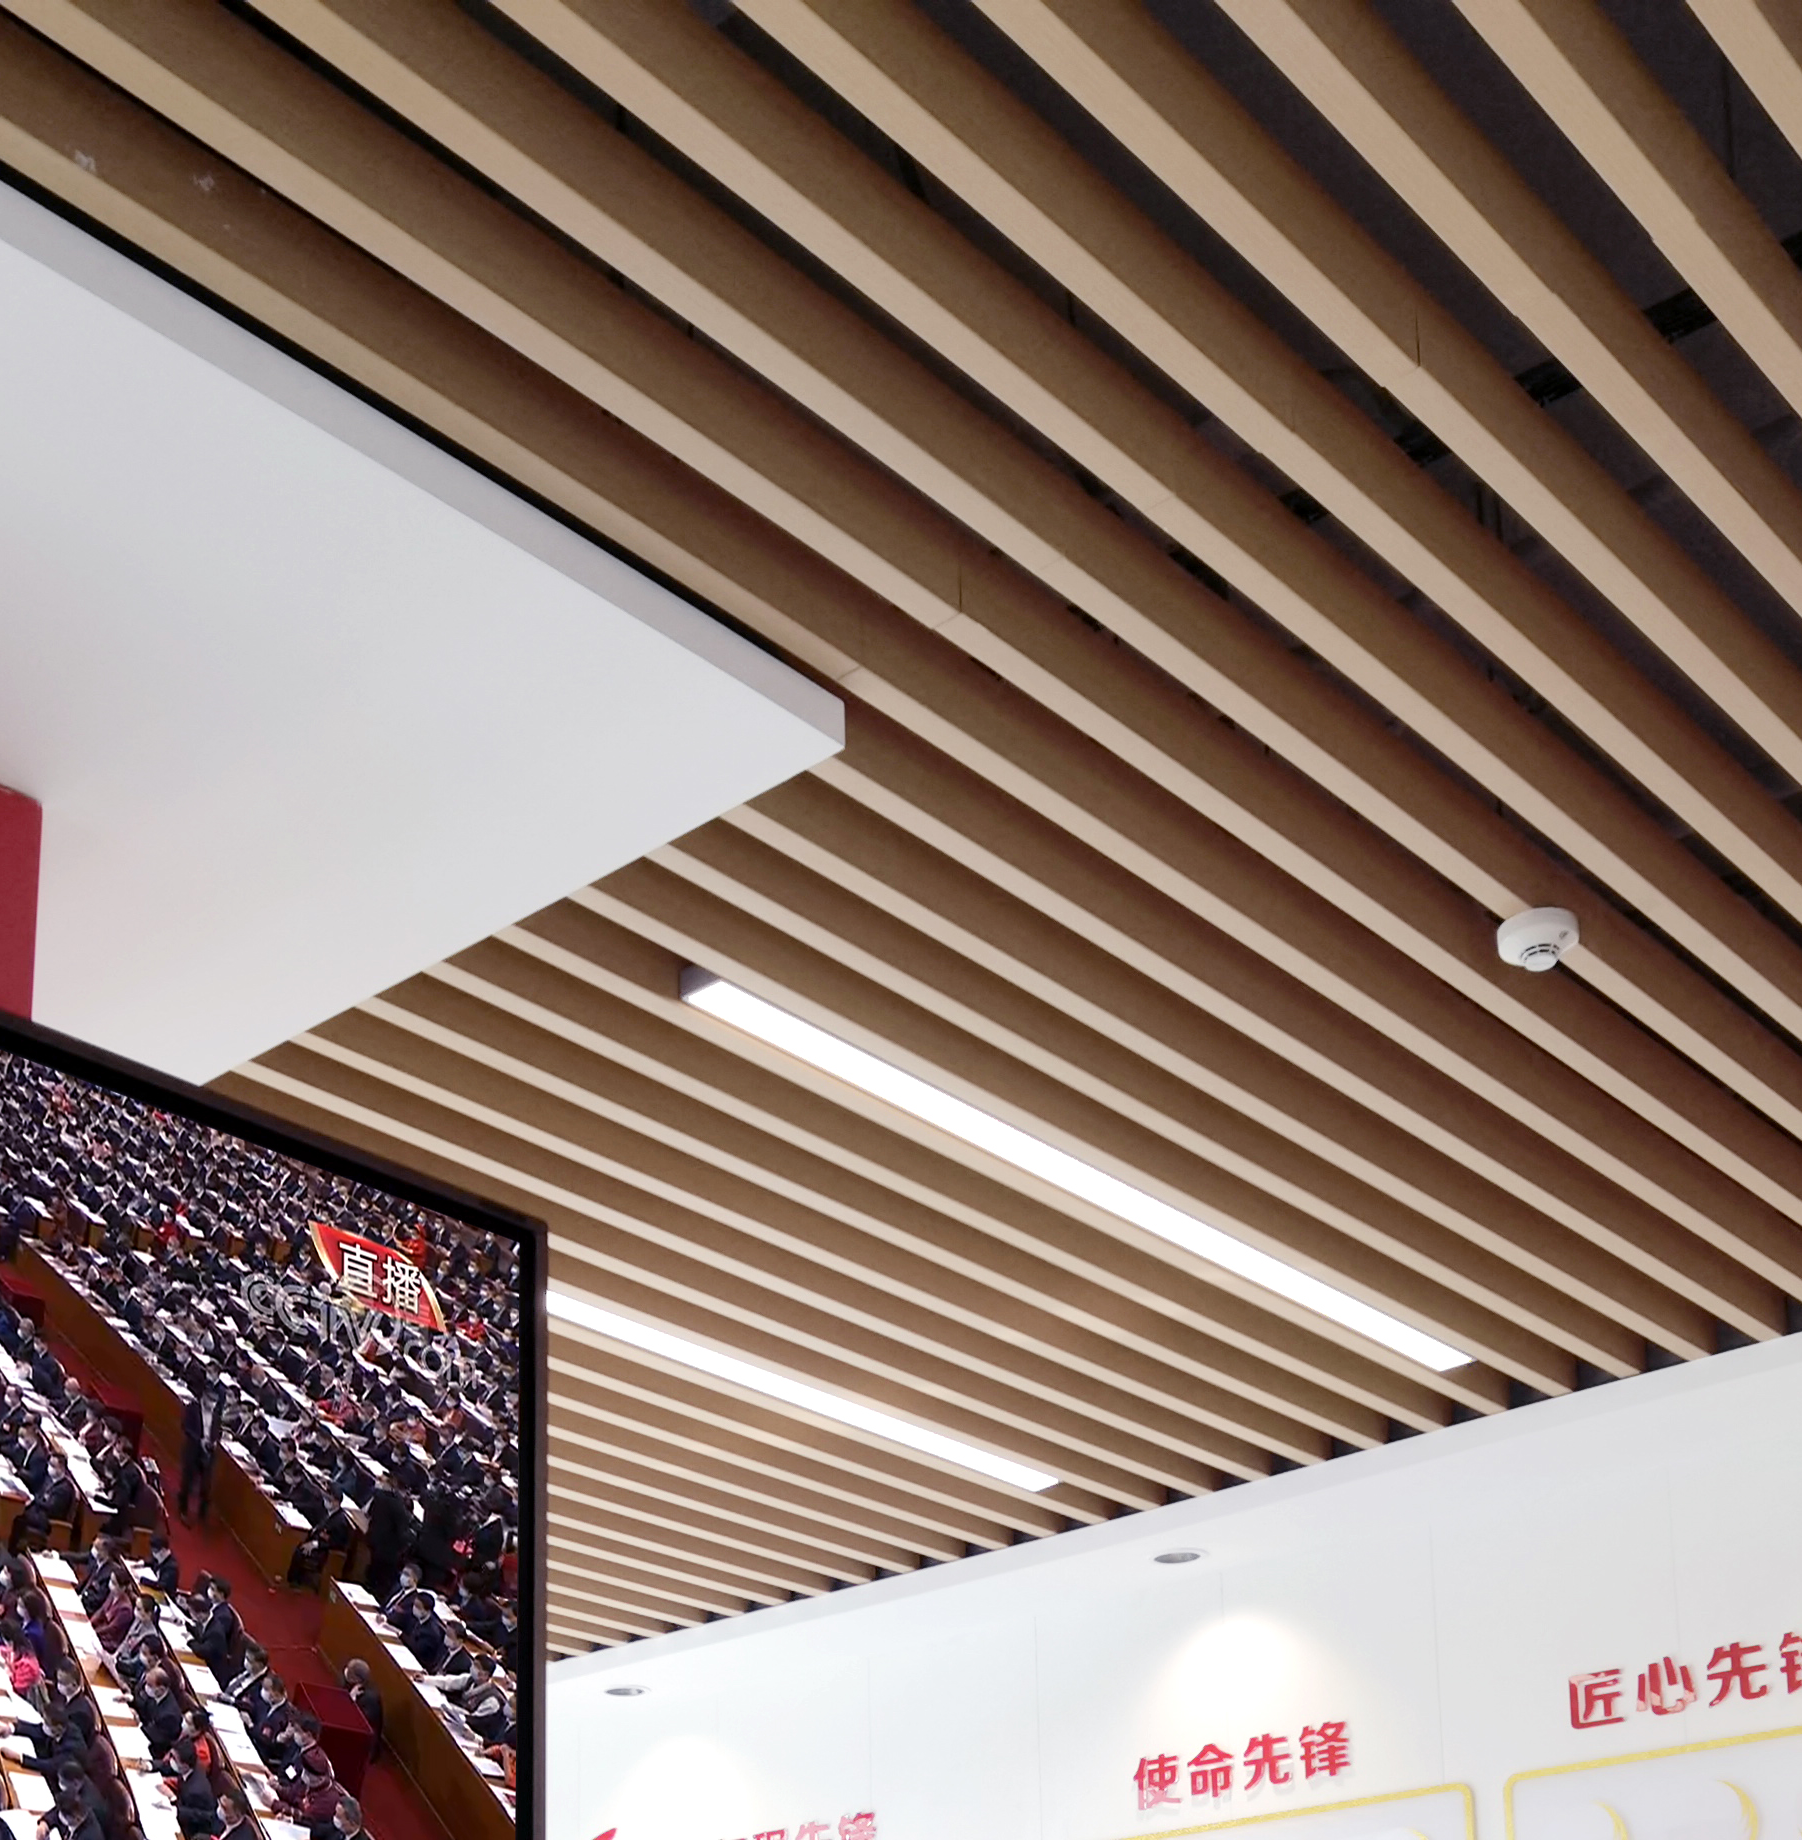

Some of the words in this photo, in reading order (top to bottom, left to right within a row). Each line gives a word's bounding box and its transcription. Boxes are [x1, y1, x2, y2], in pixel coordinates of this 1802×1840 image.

[338, 1242, 423, 1315] 直播
[1133, 1721, 1353, 1811] 使命先锋
